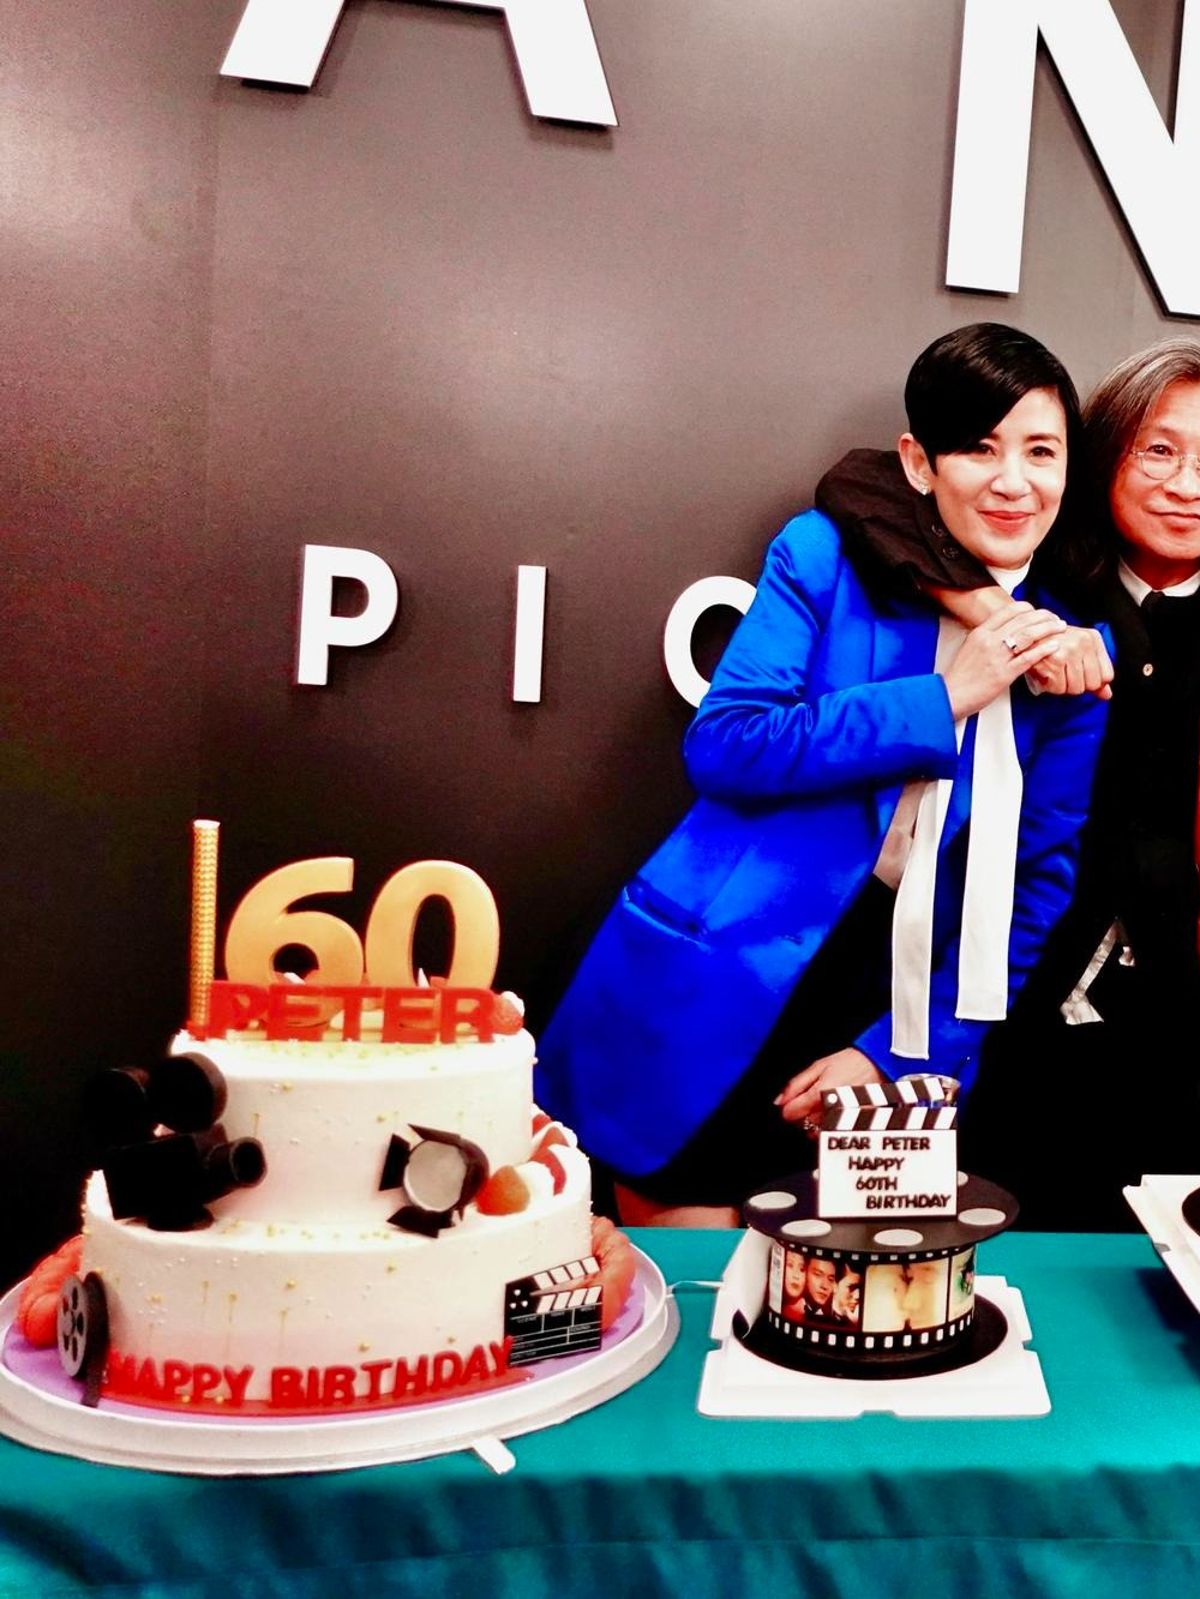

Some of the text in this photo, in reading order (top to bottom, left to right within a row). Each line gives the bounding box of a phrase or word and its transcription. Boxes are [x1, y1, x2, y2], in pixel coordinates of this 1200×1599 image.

[225, 857, 500, 1026] 60
[206, 980, 497, 1043] PETER
[828, 1137, 930, 1150] DEAR PETER
[848, 1156, 905, 1170] HAPPY
[856, 1176, 897, 1191] 60TH
[866, 1194, 950, 1209] BIRTHDAY
[106, 1336, 513, 1408] HAPPY BIRTHDAY
